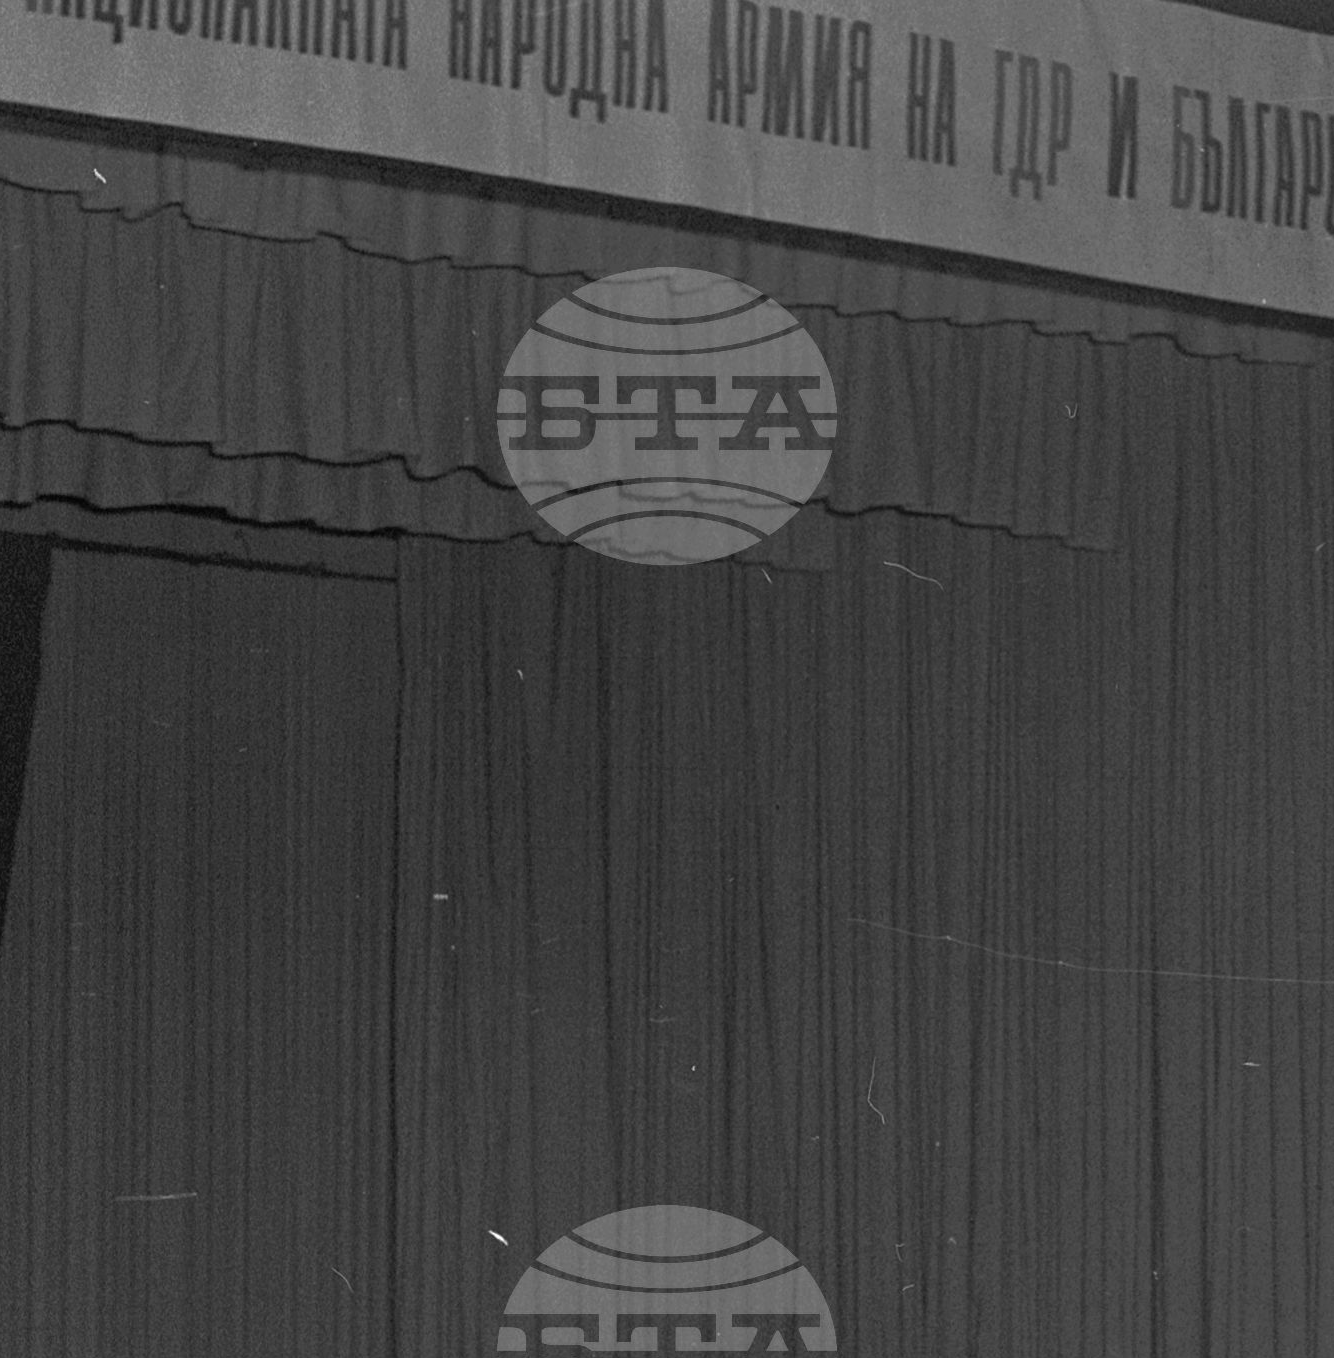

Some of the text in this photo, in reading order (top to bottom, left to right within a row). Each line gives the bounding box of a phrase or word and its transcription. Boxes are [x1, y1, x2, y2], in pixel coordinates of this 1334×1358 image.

[707, 0, 872, 150] АРМИЯ
[906, 31, 957, 167] НА
[991, 48, 1073, 200] ГДР
[1106, 71, 1139, 199] И
